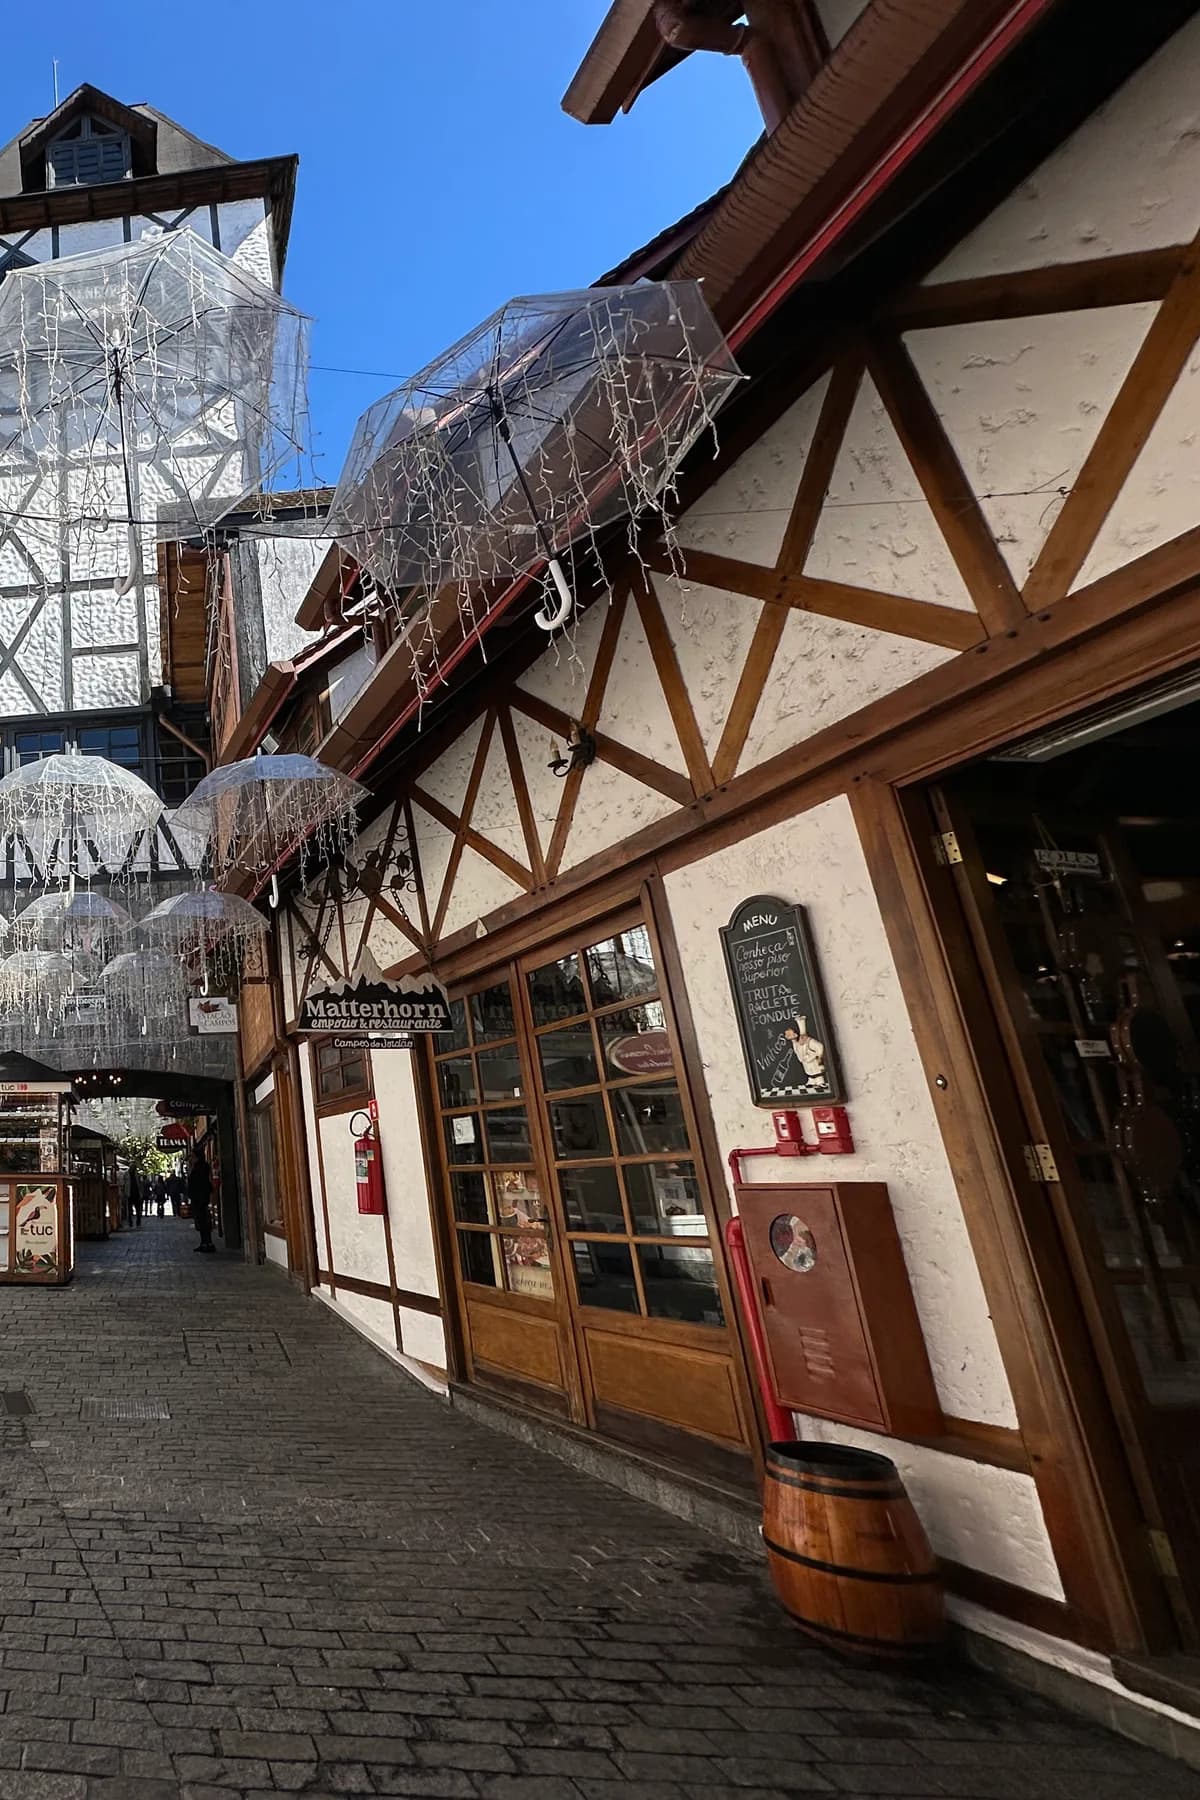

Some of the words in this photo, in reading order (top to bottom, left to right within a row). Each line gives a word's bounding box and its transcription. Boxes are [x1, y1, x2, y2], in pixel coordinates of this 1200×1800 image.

[743, 914, 778, 932] MENU
[736, 941, 788, 961] Conheça
[739, 958, 765, 970] nosso
[766, 952, 791, 968] piso
[305, 999, 447, 1018] Matterhorn
[748, 994, 800, 1015] RACLETE
[369, 1017, 443, 1029] restaurante
[750, 1007, 801, 1031] FONDUE
[334, 1038, 370, 1049] Campos
[30, 1224, 54, 1236] tuc
